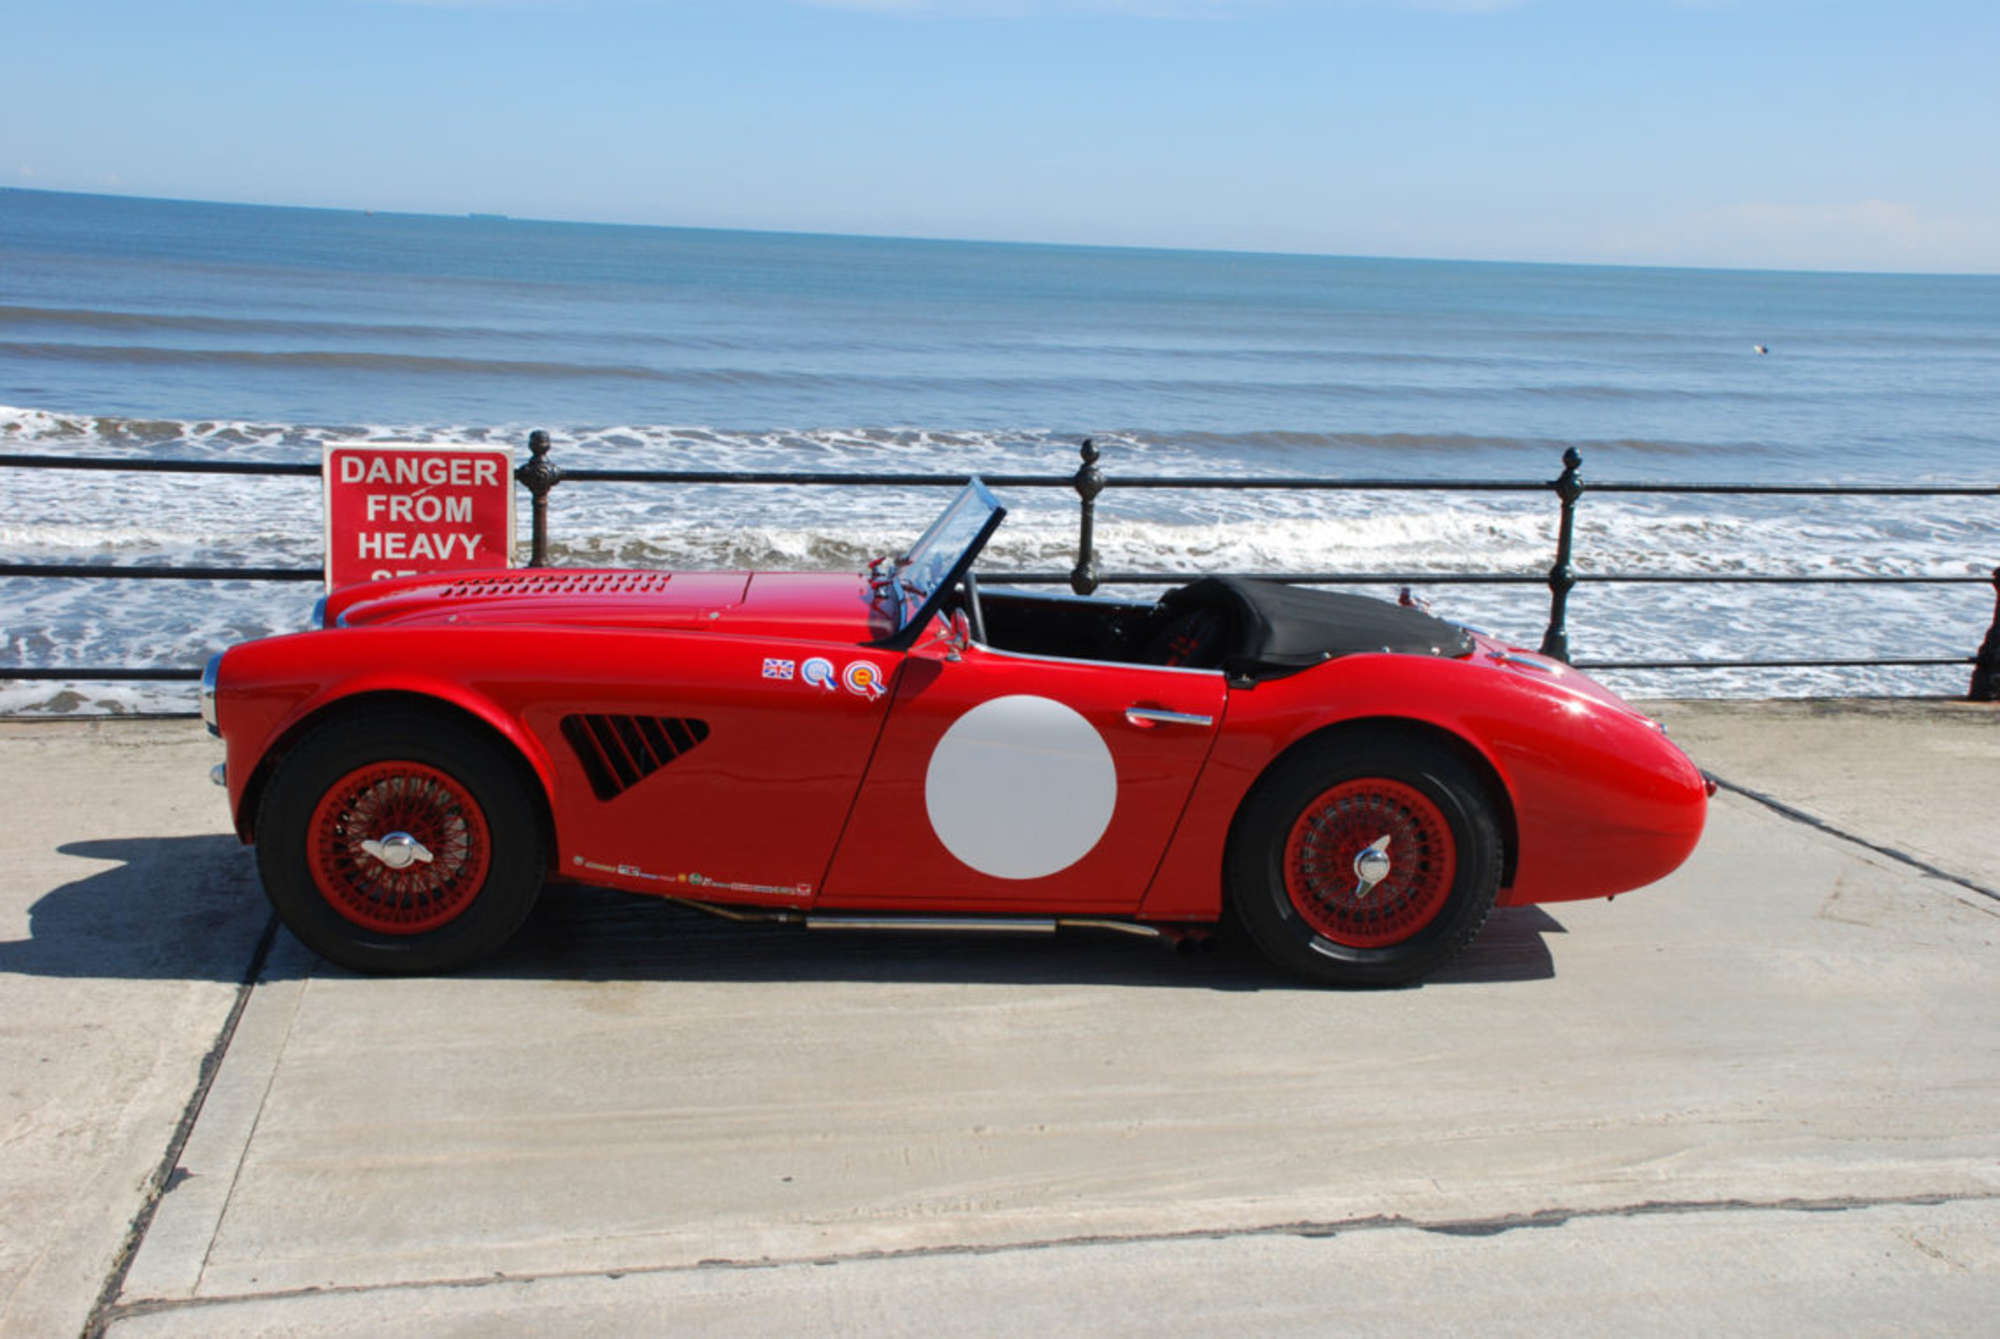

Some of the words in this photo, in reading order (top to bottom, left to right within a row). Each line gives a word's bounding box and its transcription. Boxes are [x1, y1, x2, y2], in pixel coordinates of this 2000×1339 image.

[340, 456, 499, 486] DANGER
[367, 494, 473, 523] FROM
[358, 532, 483, 560] HEAVY
